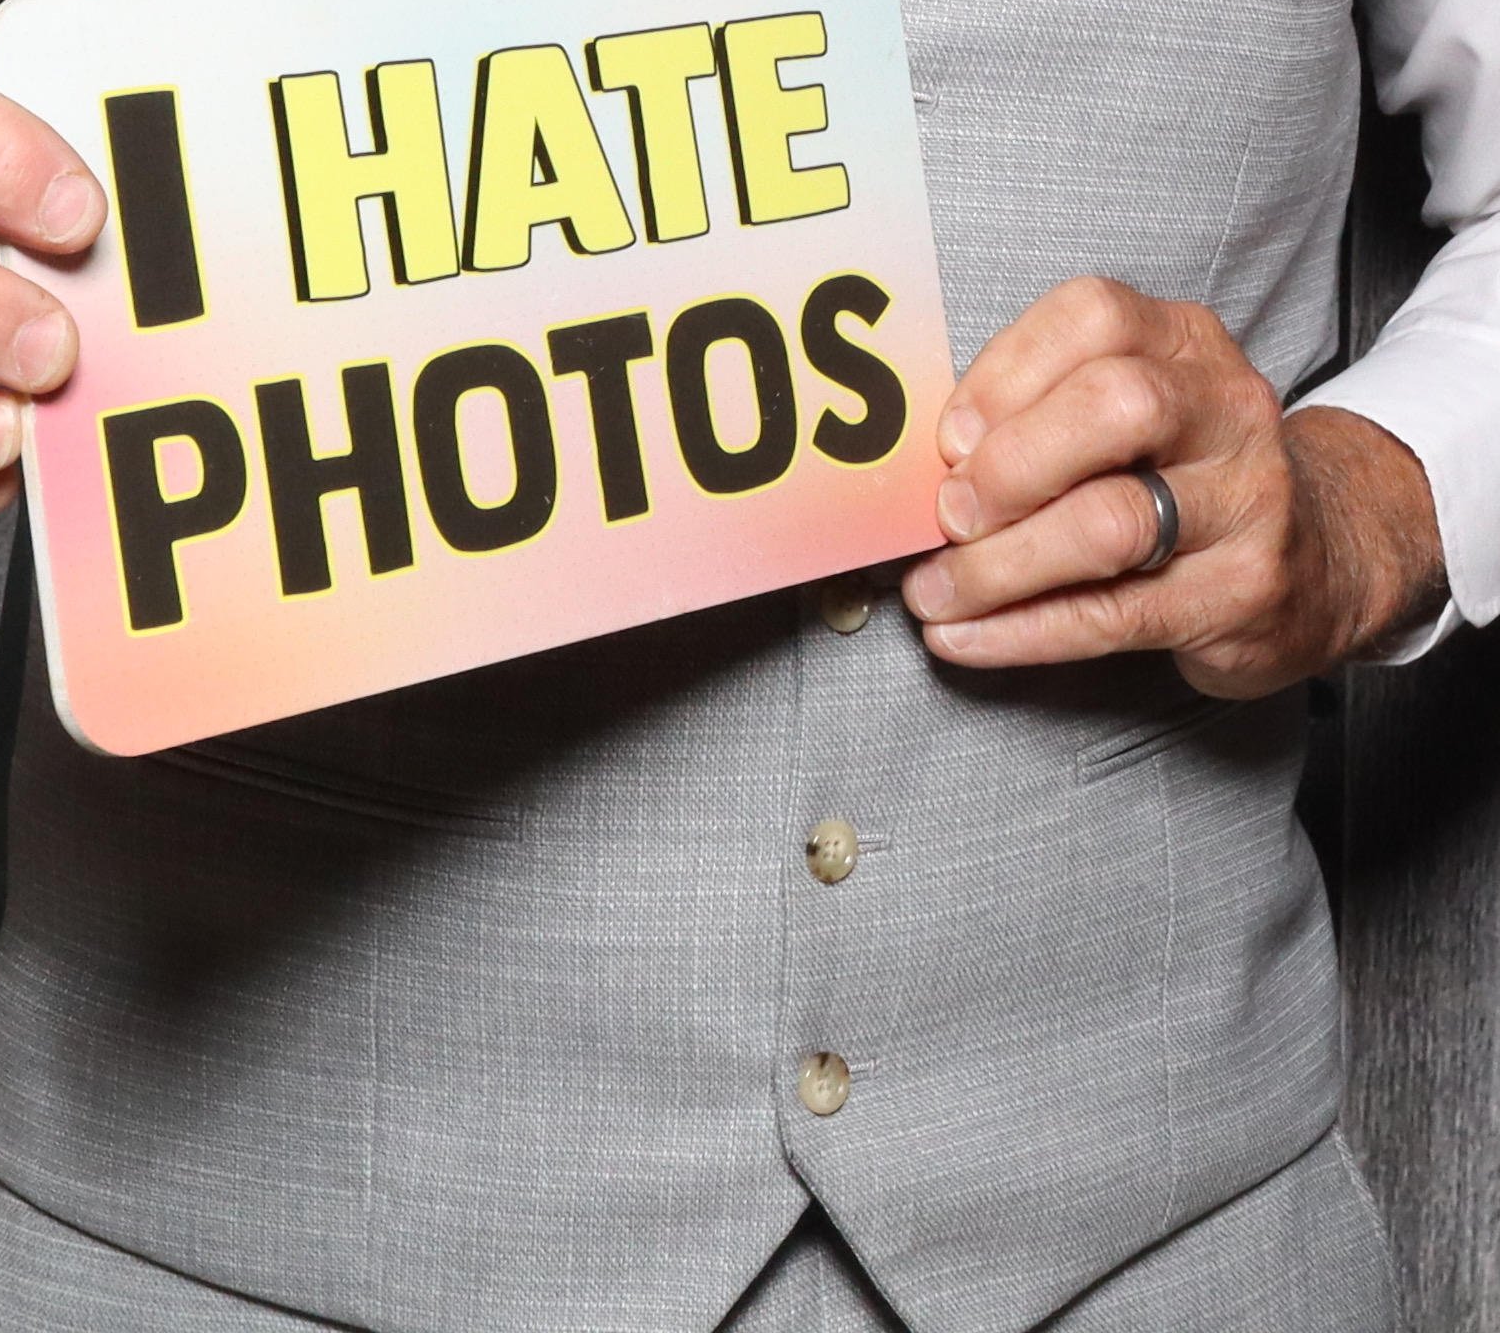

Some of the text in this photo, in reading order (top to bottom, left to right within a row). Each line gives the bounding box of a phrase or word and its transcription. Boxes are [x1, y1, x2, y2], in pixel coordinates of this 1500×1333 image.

[100, 10, 852, 334] I HATE
[97, 269, 909, 637] PHOTOS
